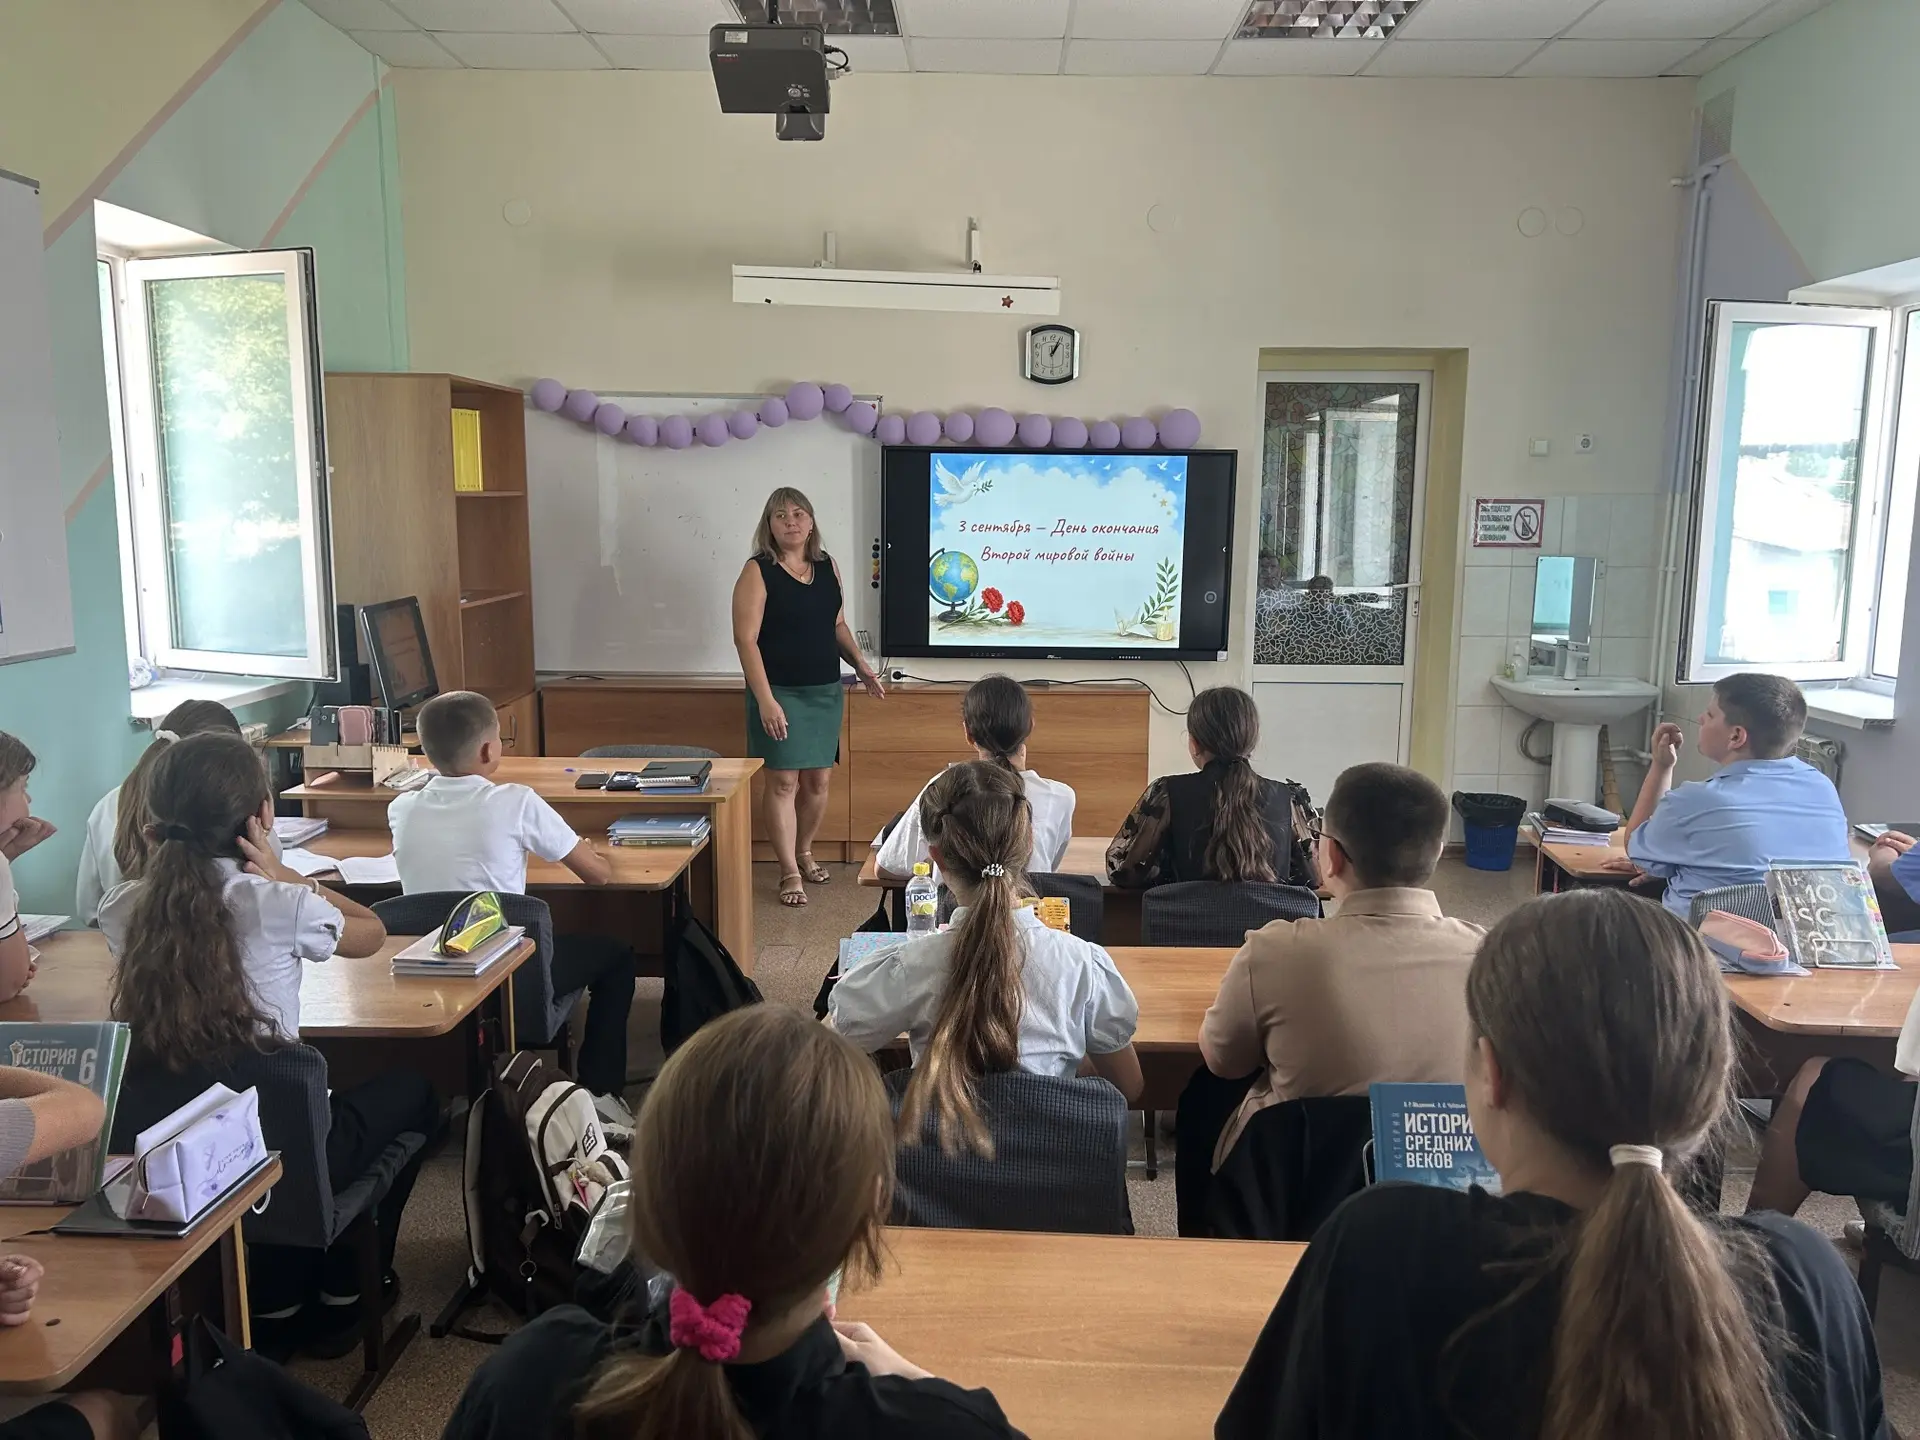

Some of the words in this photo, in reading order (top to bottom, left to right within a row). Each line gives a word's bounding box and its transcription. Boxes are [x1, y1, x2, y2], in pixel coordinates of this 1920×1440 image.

[959, 521, 966, 532] 3
[971, 520, 1031, 536] сентября
[1050, 519, 1087, 536] День
[1092, 525, 1159, 535] окончания
[981, 546, 1030, 563] Второй
[1035, 547, 1089, 564] мировой
[1094, 548, 1134, 562] войны
[79, 1048, 97, 1084] 6
[1405, 1113, 1473, 1134] ИСТОРИ
[1406, 1135, 1474, 1153] СРЕДНИХ
[1407, 1152, 1453, 1168] ВЕКОВ
